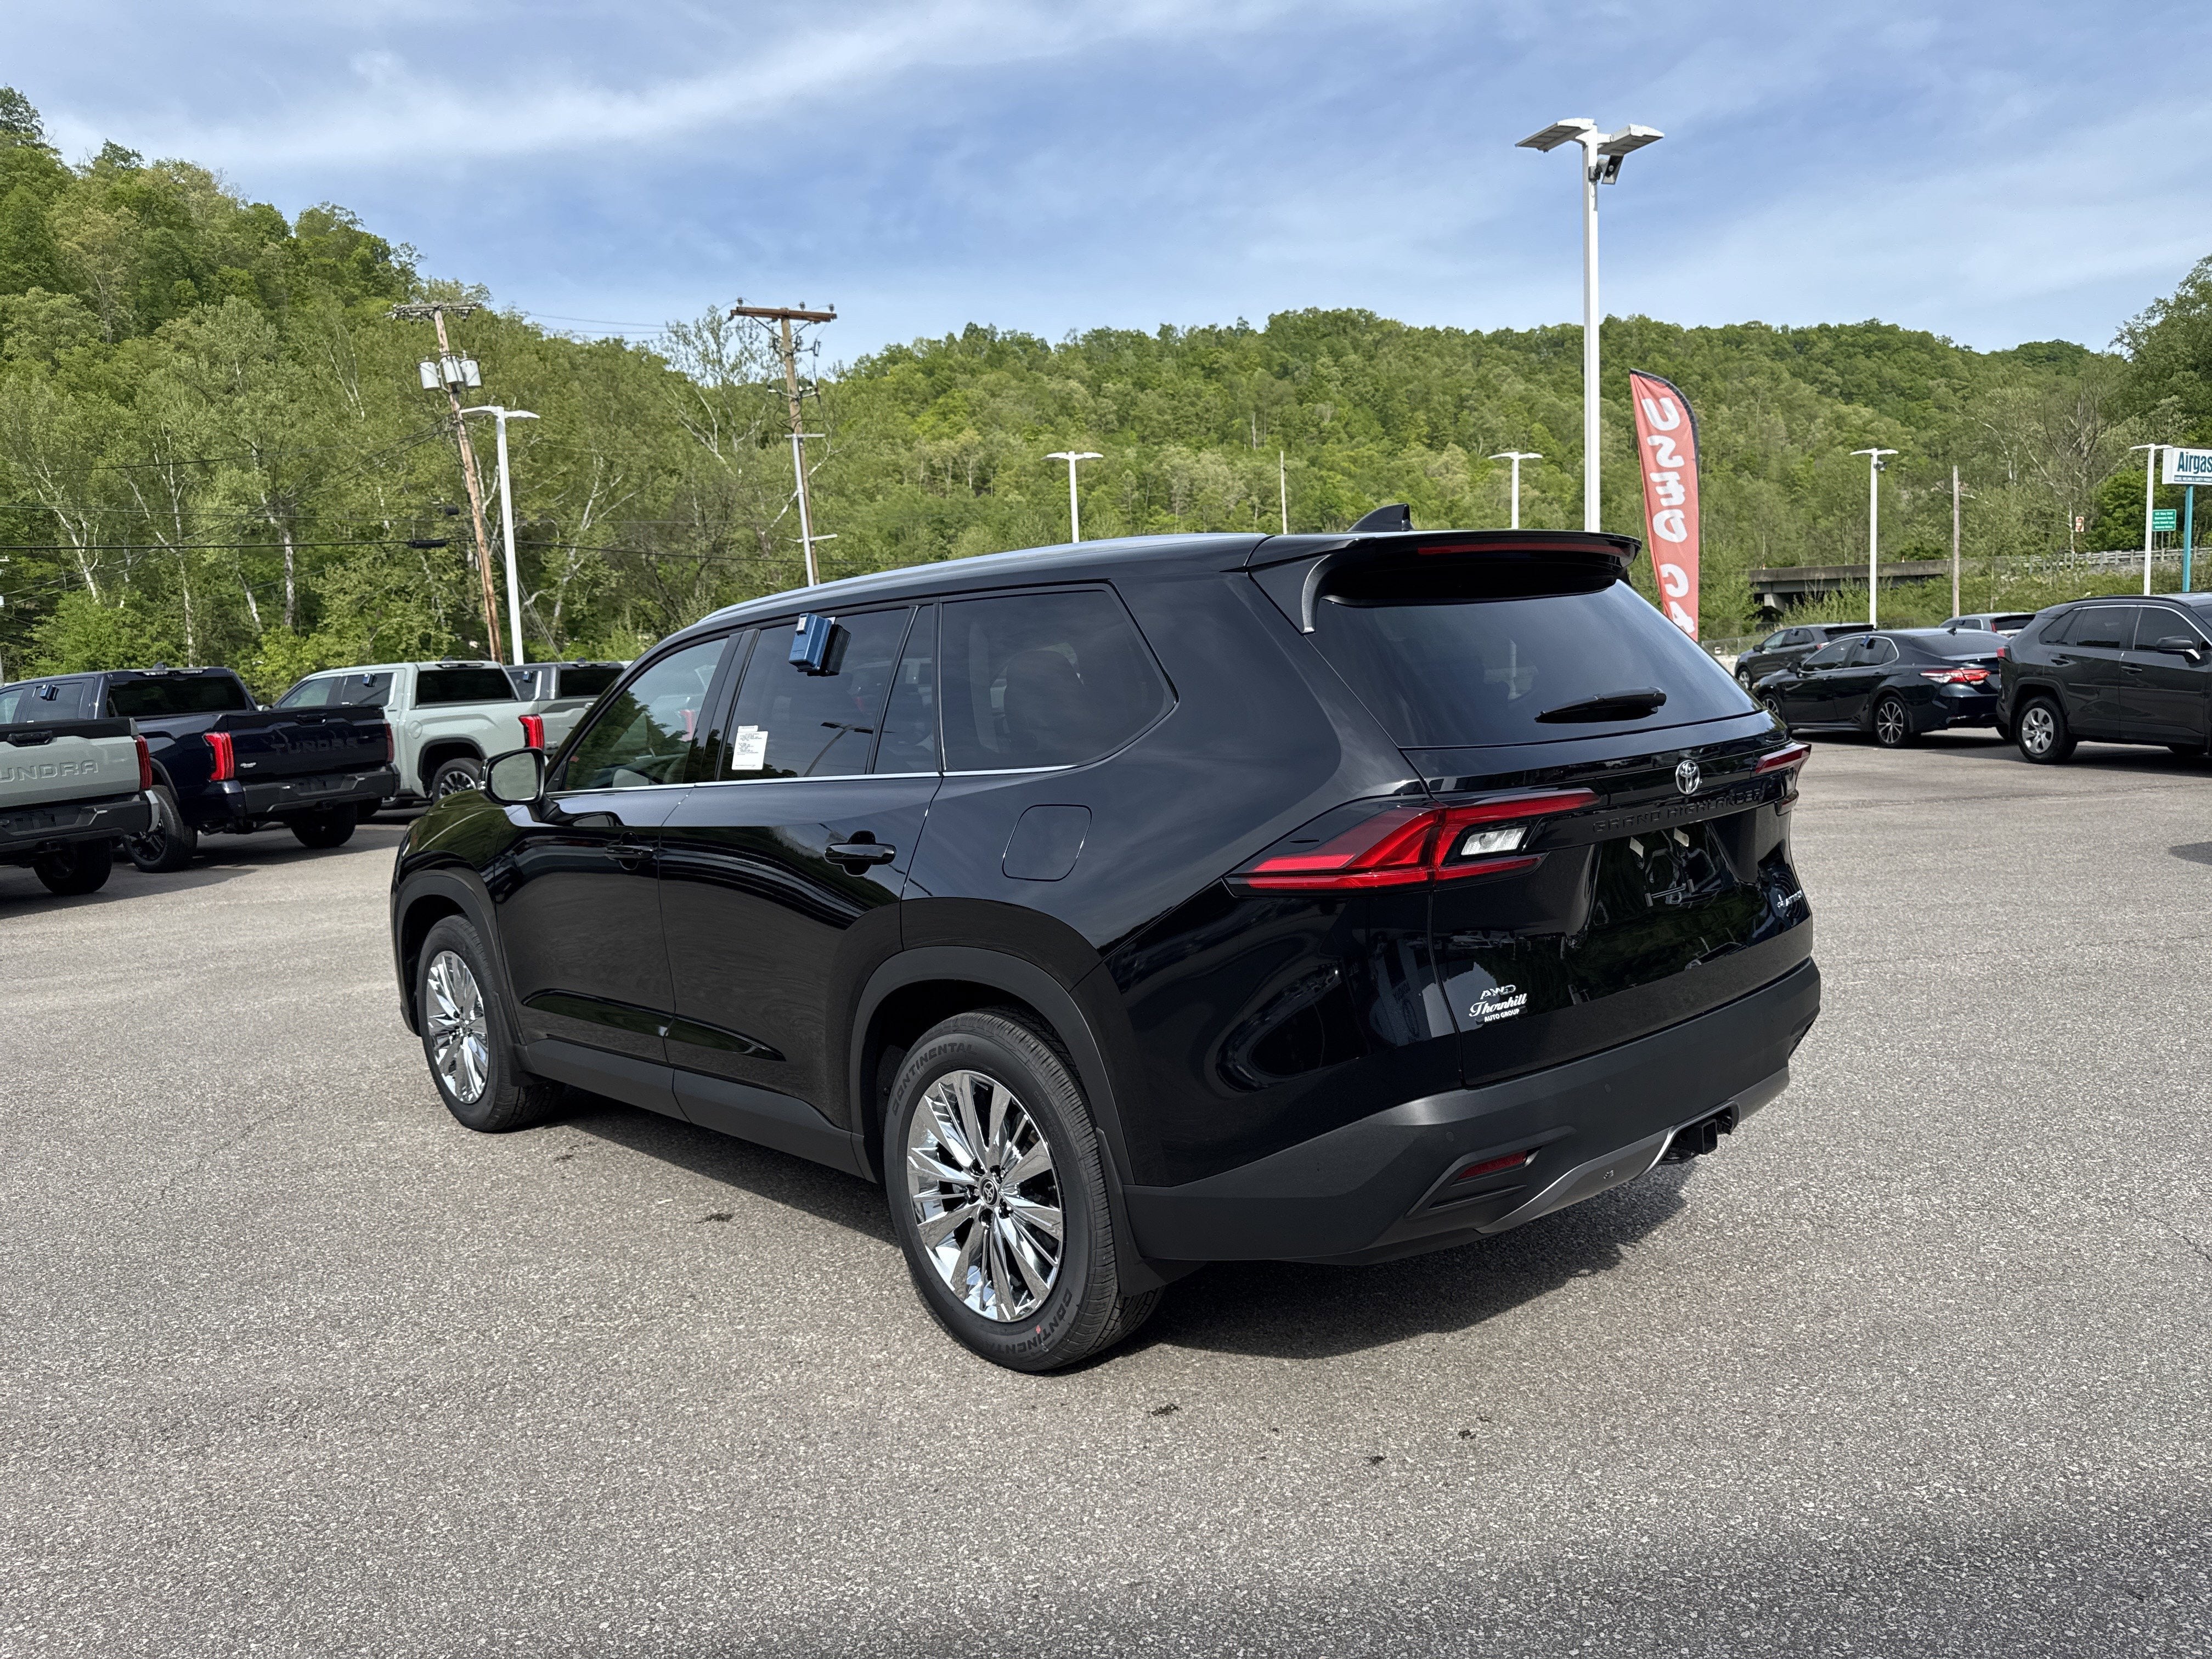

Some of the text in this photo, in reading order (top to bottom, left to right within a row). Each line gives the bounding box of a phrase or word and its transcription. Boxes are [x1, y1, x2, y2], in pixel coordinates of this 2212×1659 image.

[2177, 452, 2212, 474] Airgas
[1593, 788, 1761, 833] GRAND HIGHLANDER
[1480, 984, 1516, 1000] AWD
[1469, 993, 1527, 1017] Thornhill
[1484, 1008, 1520, 1023] AUTO GROUP
[892, 1042, 977, 1116] CONTINENTAL
